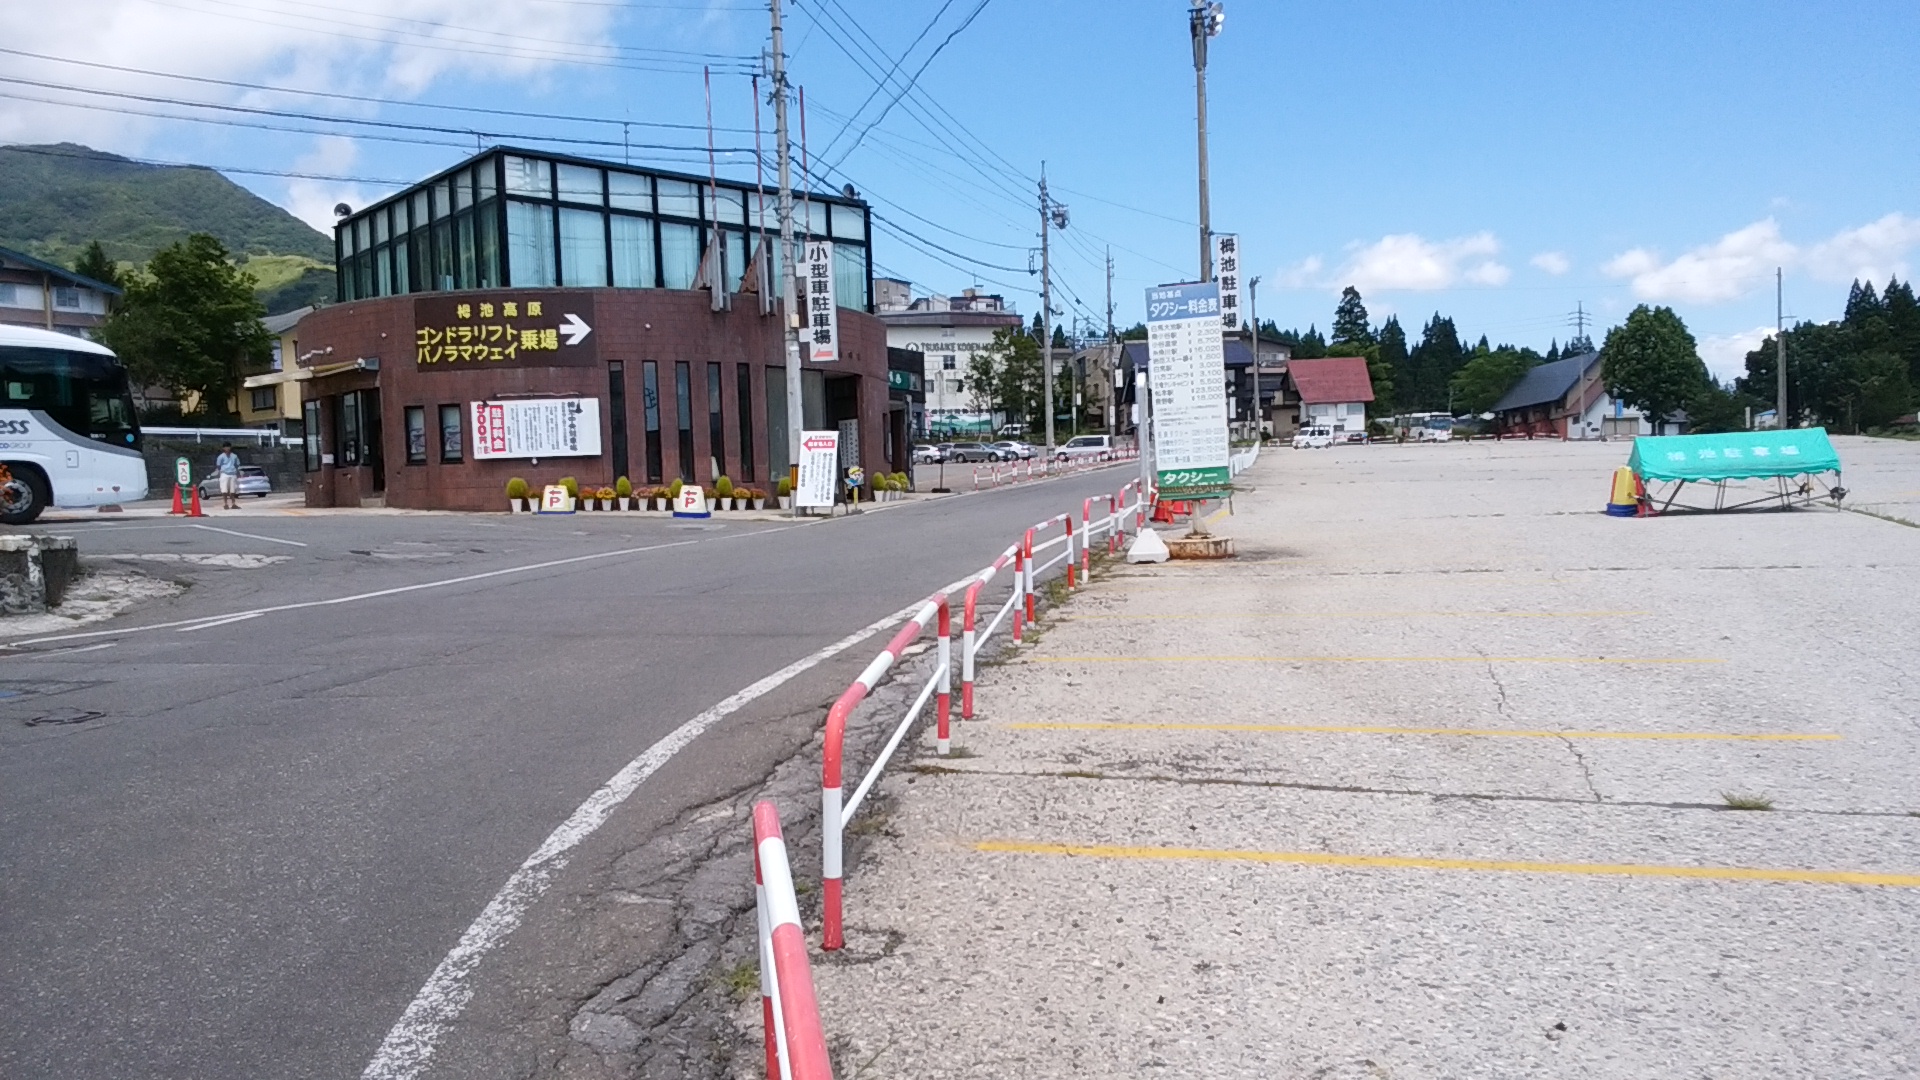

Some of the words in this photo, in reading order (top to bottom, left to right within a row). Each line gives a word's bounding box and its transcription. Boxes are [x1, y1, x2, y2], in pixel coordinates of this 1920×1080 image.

[1220, 238, 1238, 329] 栂池駐車場
[809, 245, 832, 345] 小型車駐車場
[456, 301, 543, 319] 栂池高原
[1149, 298, 1218, 318] タクシー料金表
[416, 323, 518, 346] ゴンドラリフト
[520, 328, 559, 350] 乗場
[417, 341, 519, 364] パノラマウェイ
[1164, 471, 1219, 486] タクシー
[549, 496, 562, 508] P
[684, 496, 697, 508] P
